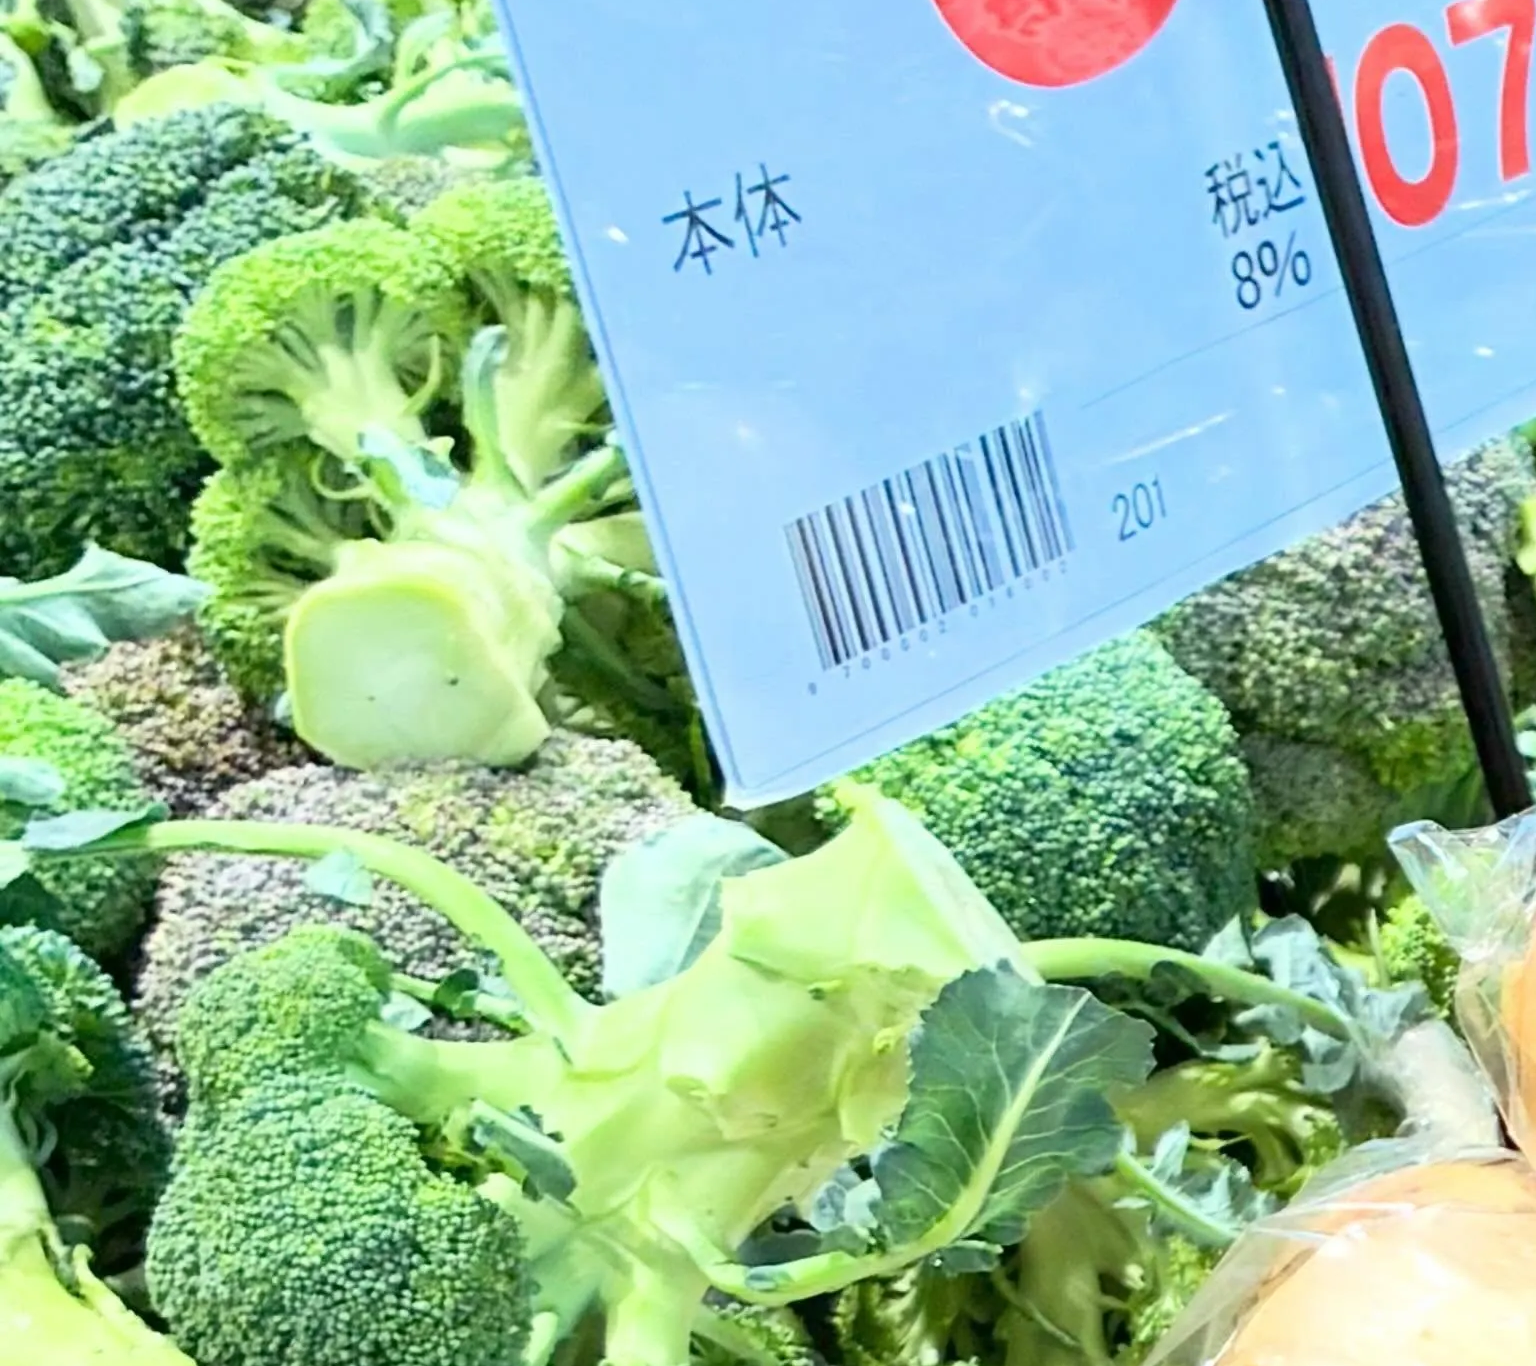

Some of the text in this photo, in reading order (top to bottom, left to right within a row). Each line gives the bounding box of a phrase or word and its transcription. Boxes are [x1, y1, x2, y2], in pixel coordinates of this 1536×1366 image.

[661, 163, 802, 275] 本体
[1204, 140, 1306, 237] 税込
[1232, 230, 1312, 310] 8%
[1112, 473, 1167, 542] 201
